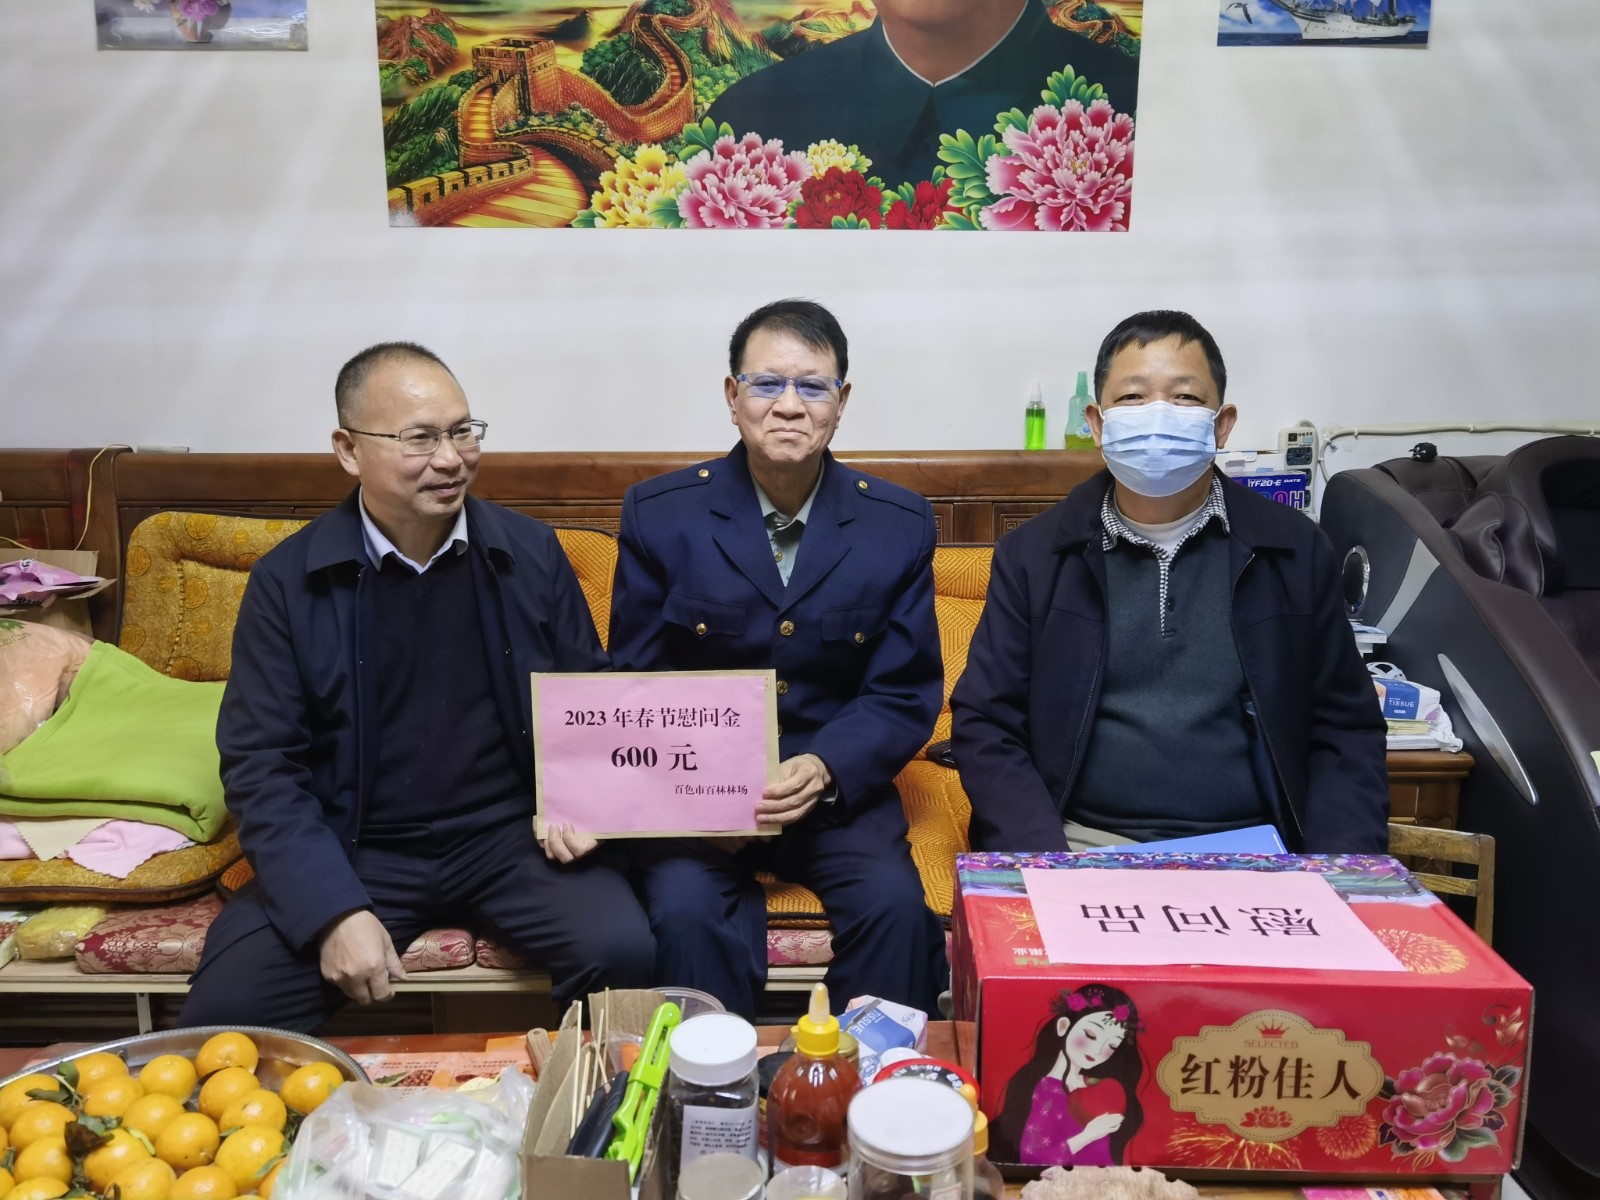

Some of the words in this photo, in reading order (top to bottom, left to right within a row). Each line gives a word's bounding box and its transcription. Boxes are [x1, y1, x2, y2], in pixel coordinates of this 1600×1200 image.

[1388, 699, 1415, 708] TISSUE
[564, 710, 607, 726] 2023
[612, 706, 741, 729] 年春节慰问金
[611, 746, 658, 768] 600
[666, 743, 699, 771] 元
[674, 784, 748, 796] 百色市百林林场
[1080, 904, 1321, 937] 慰问品
[852, 1009, 882, 1035] TISSUE
[1244, 1039, 1299, 1049] SELECTED
[1180, 1053, 1362, 1100] 红粉佳人
